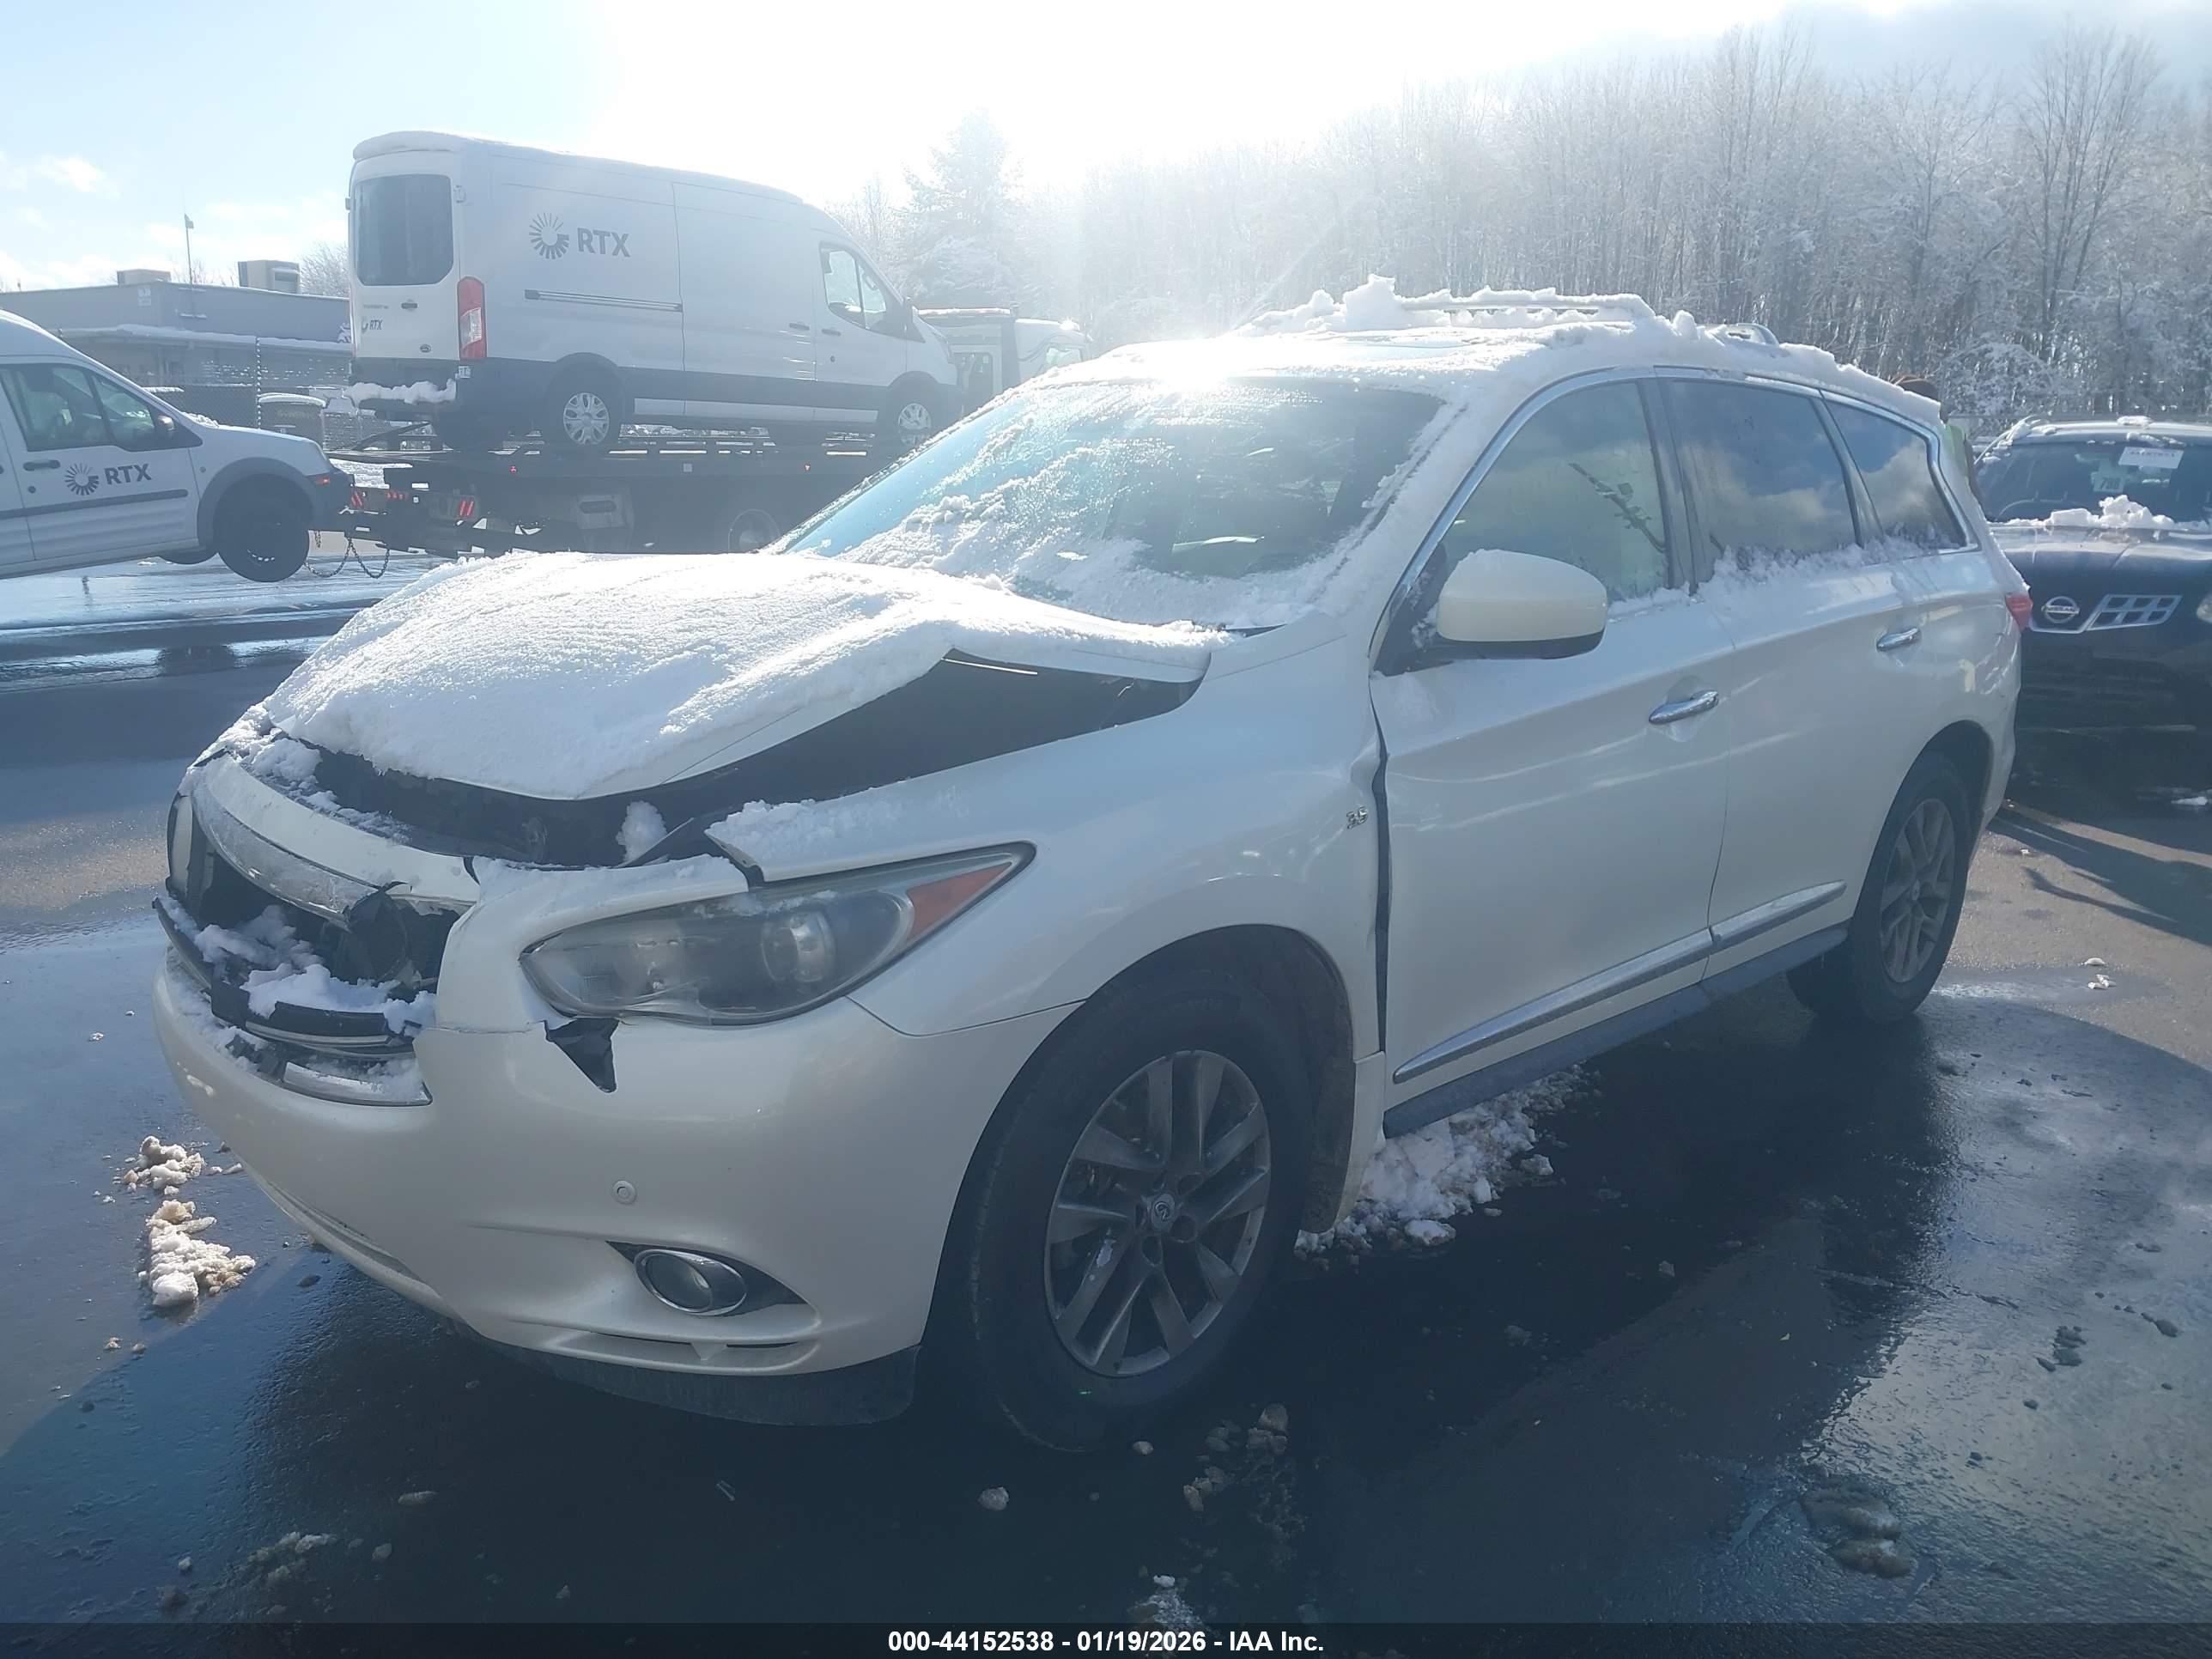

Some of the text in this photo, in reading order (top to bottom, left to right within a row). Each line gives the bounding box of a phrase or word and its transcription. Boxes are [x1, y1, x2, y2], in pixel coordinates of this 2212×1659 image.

[577, 227, 631, 258] RTX
[369, 319, 383, 331] RTX
[104, 464, 152, 485] RTX
